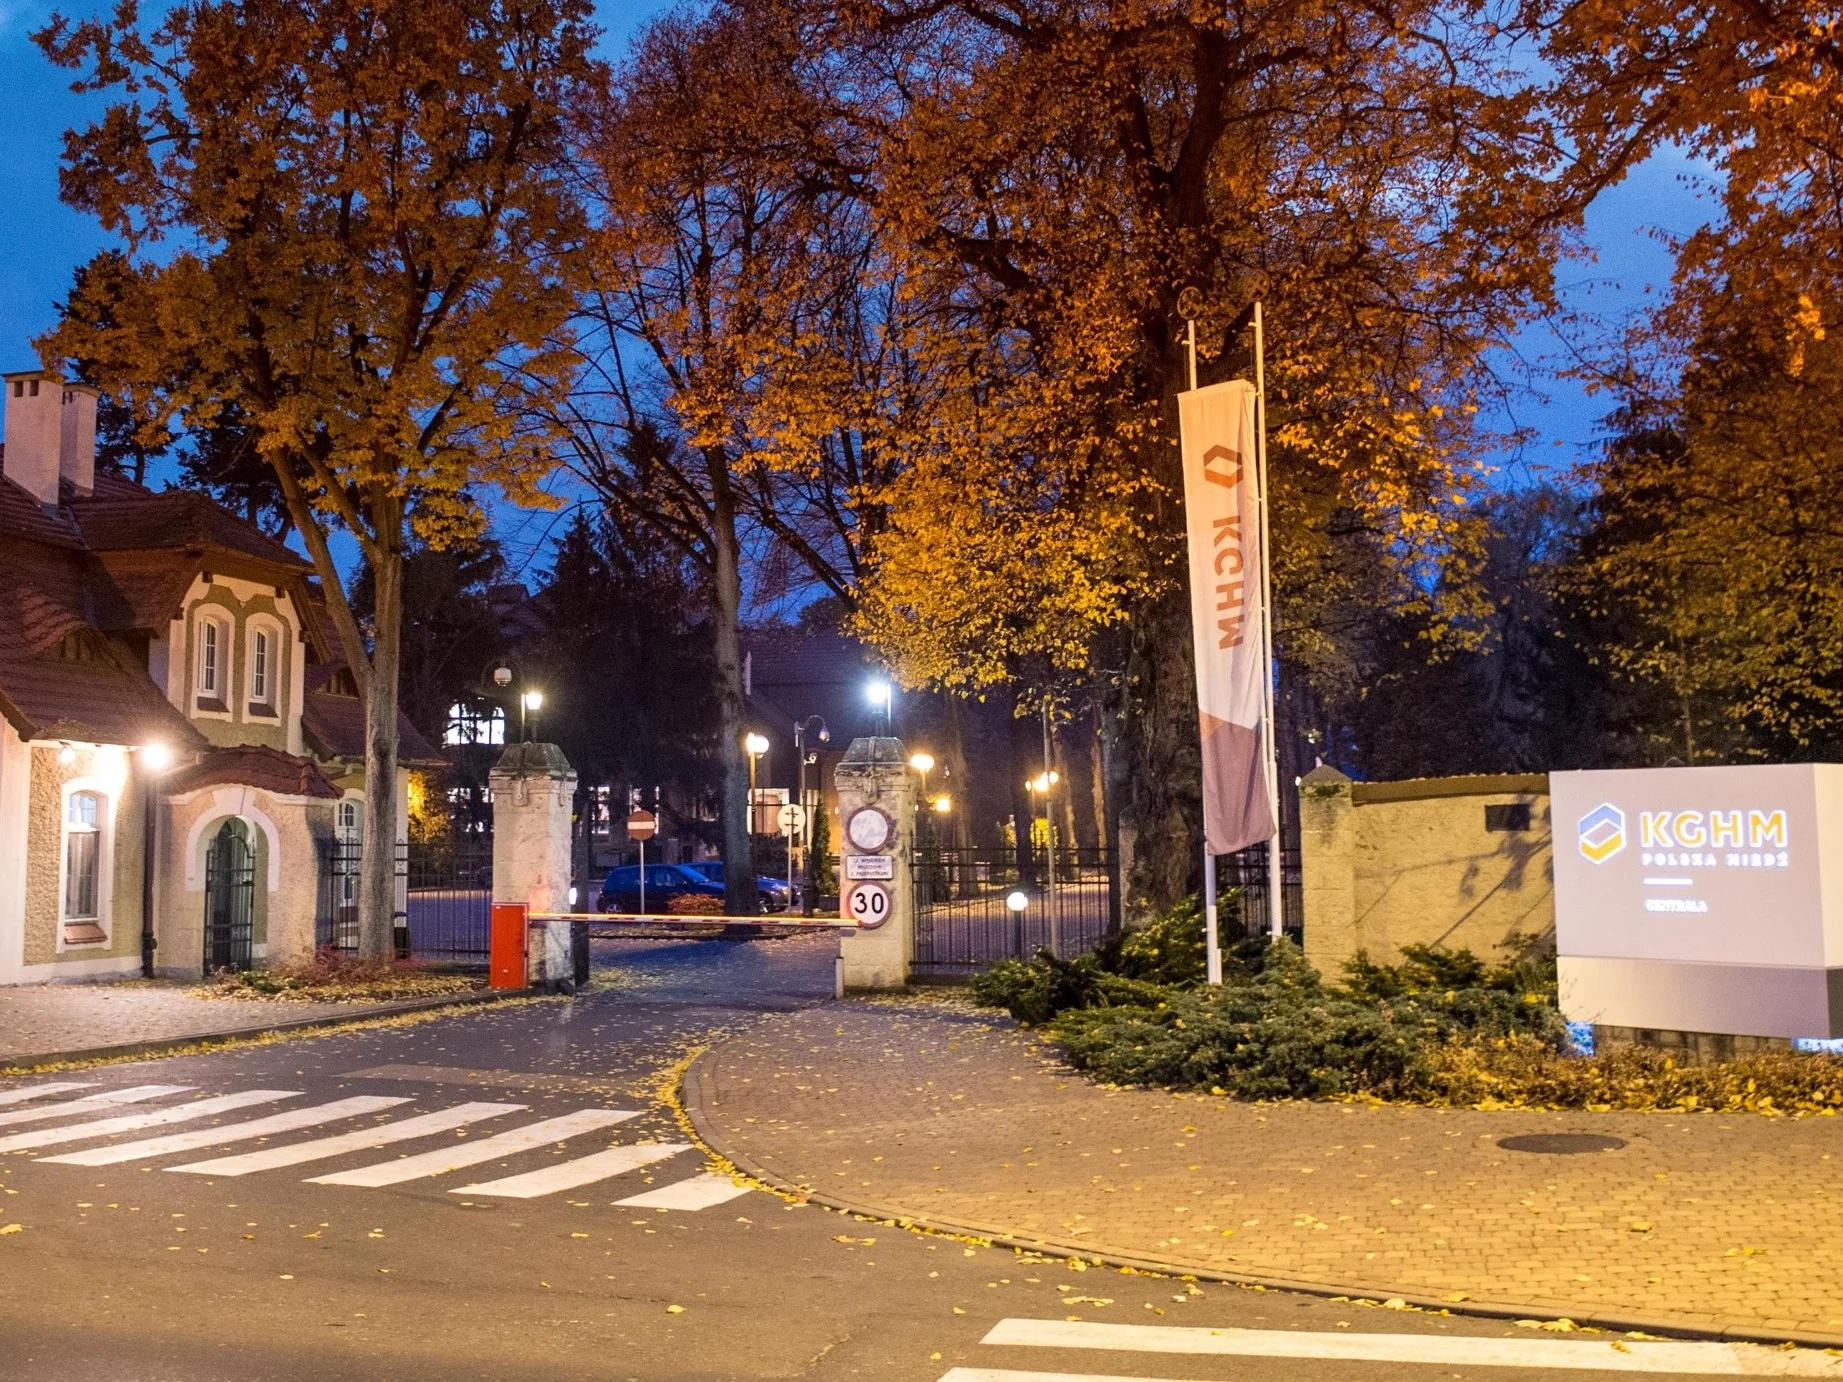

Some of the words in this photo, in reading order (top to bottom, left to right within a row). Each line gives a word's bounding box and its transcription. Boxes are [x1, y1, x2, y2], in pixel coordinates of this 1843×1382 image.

[1640, 810, 1788, 848] KGHM
[1642, 853, 1717, 866] POLSKA
[854, 892, 884, 914] 30
